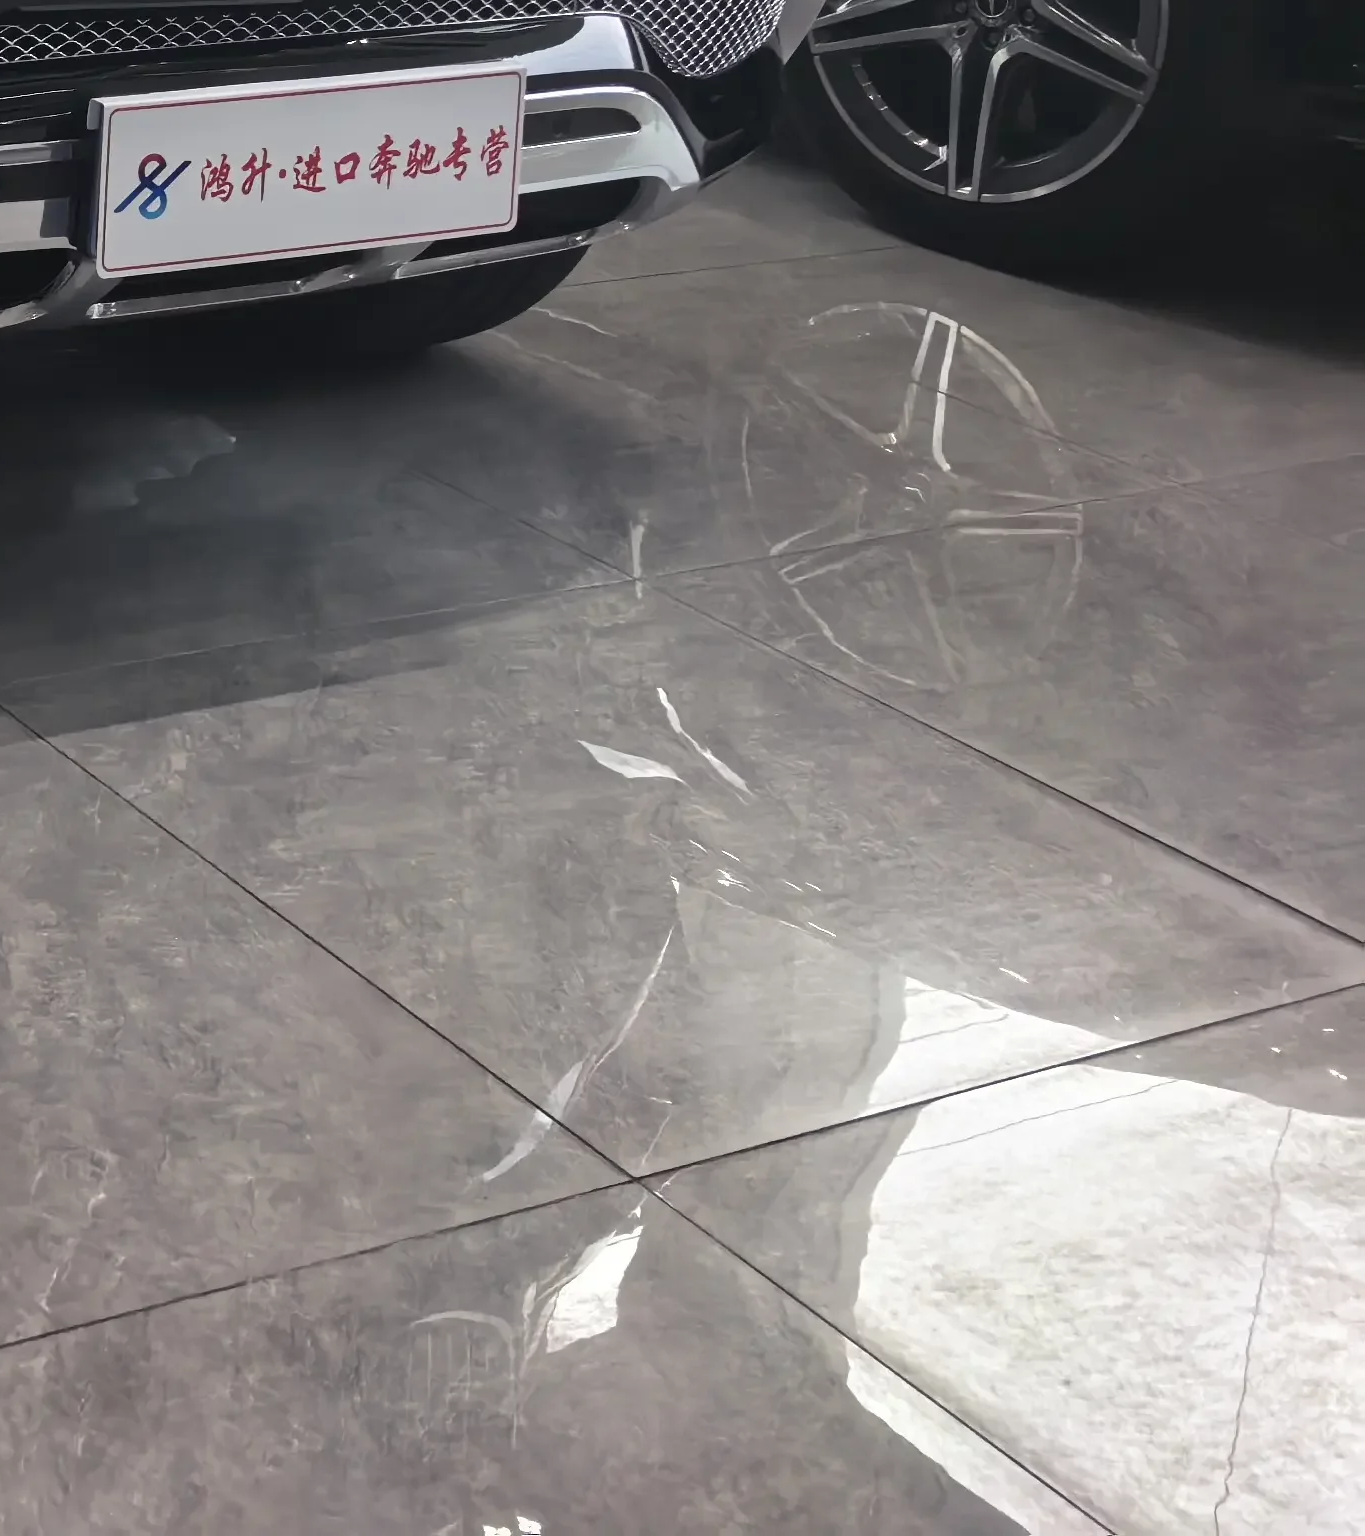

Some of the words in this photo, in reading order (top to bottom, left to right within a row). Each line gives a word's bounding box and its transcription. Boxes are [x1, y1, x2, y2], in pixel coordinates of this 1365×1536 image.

[199, 125, 510, 204] 鸿升·进口奔驰专营
